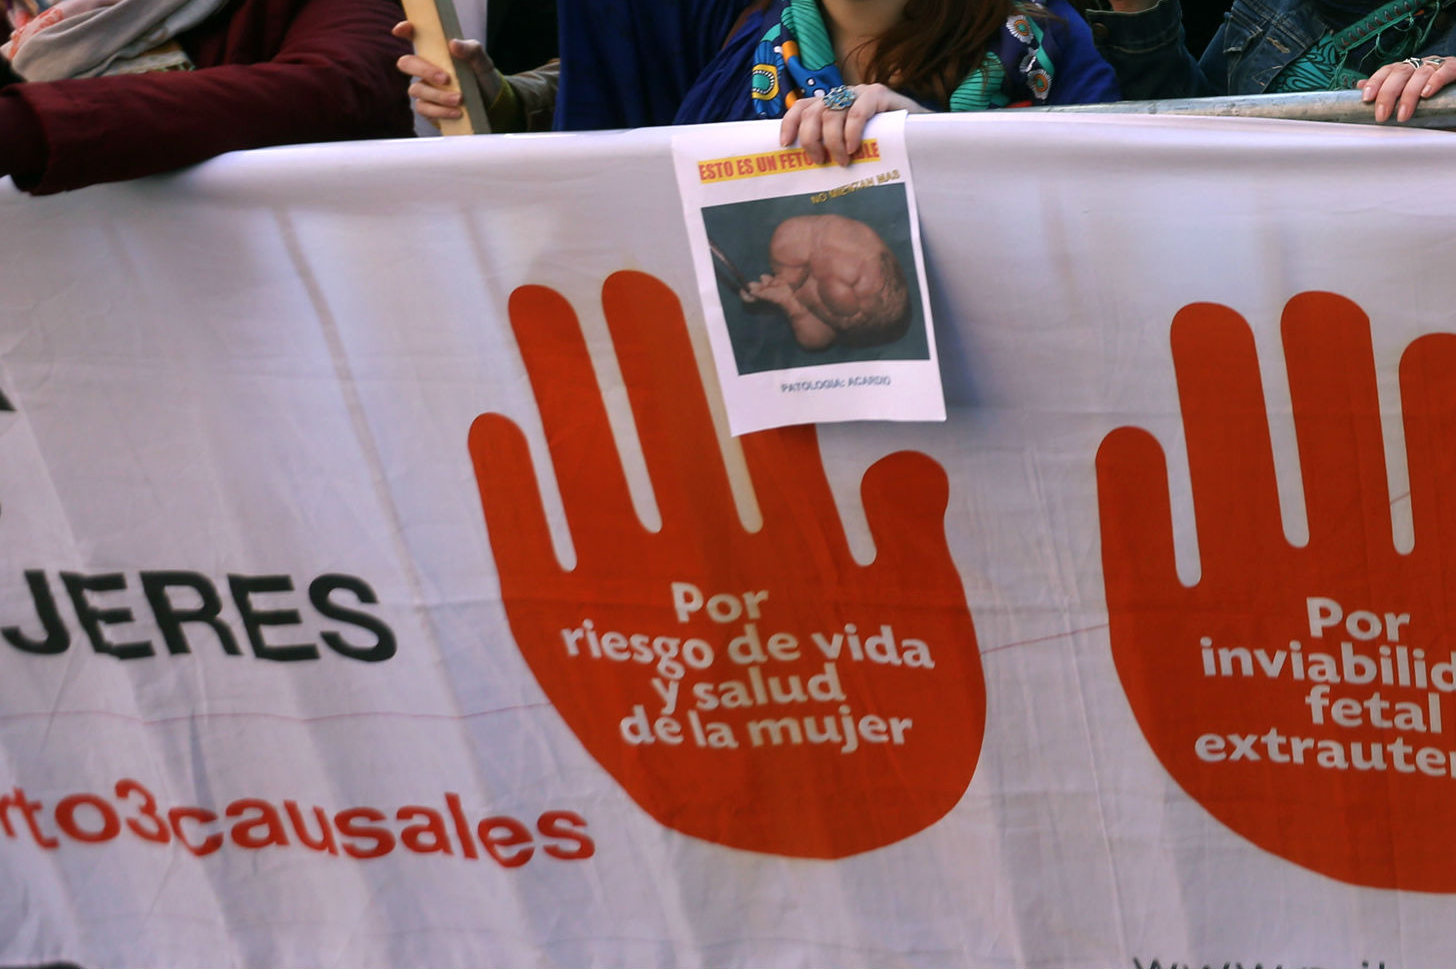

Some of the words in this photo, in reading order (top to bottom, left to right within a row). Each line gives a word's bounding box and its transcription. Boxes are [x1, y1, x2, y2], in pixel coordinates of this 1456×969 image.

[698, 161, 733, 181] ESTO
[736, 160, 754, 176] ES
[756, 155, 777, 172] UN
[1, 569, 398, 663] JERES
[671, 581, 769, 623] Por
[1306, 597, 1410, 642] Por
[560, 618, 715, 680] riesgo
[727, 622, 802, 666] de
[810, 623, 936, 669] vida
[651, 676, 680, 716] y
[692, 662, 847, 712] salud
[1305, 684, 1442, 733] fetal
[619, 704, 684, 745] de
[687, 710, 739, 750] la
[747, 705, 913, 754] mujer
